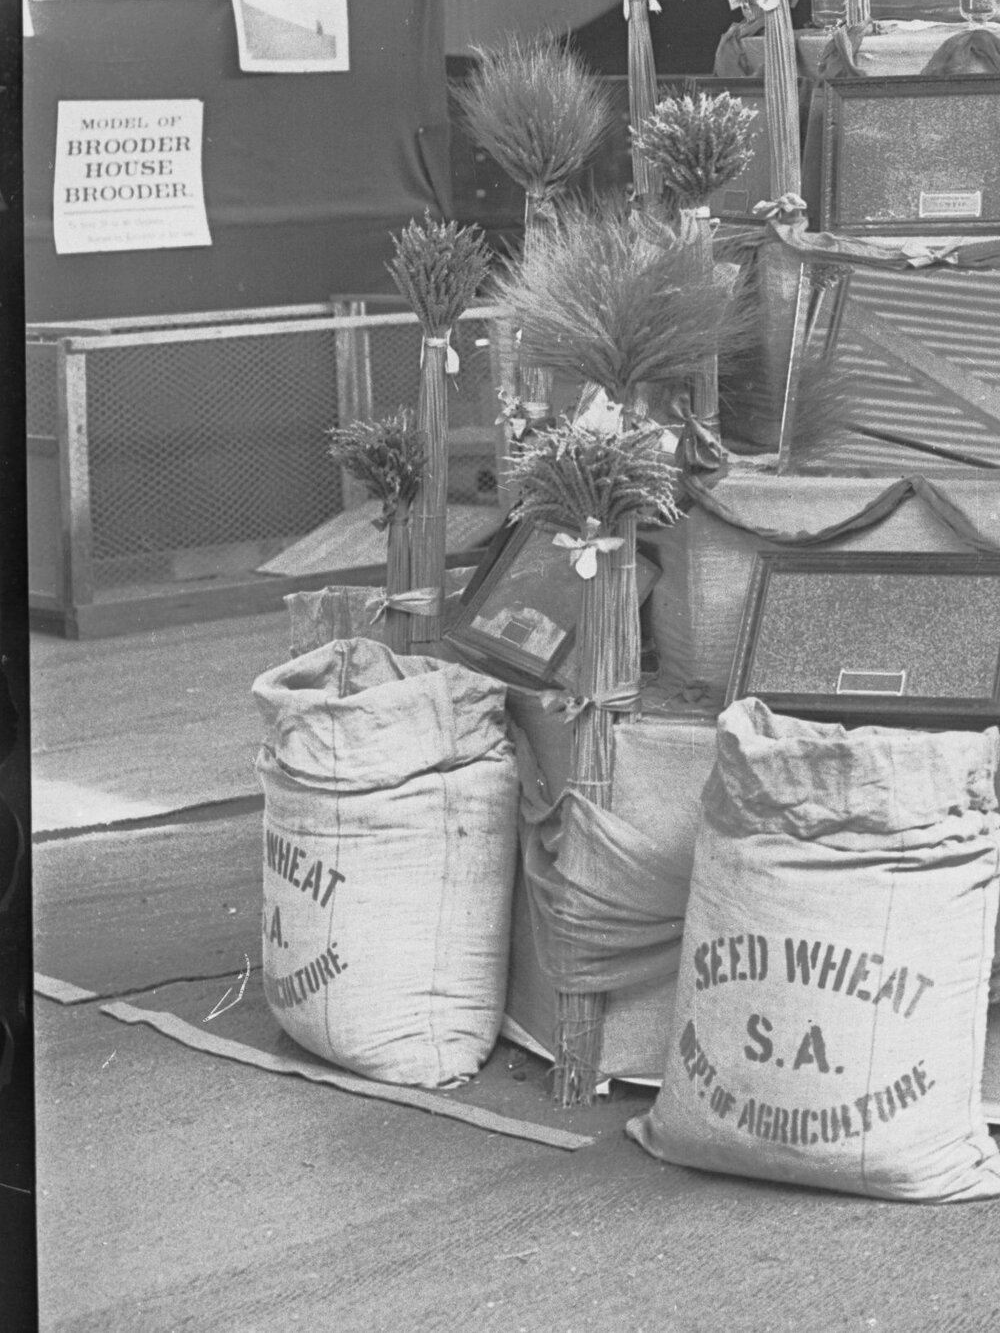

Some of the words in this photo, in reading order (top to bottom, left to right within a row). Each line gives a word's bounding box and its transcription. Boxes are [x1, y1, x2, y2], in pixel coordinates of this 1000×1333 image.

[67, 136, 191, 156] BROODER
[80, 117, 149, 130] MODEL
[157, 116, 182, 128] OF
[84, 159, 174, 178] HOUSE
[266, 829, 346, 908] WHEAT
[694, 933, 768, 991] SEED
[783, 936, 935, 1018] WHEAT
[710, 1084, 737, 1119] OF
[737, 1059, 936, 1146] AGRICULTURE
